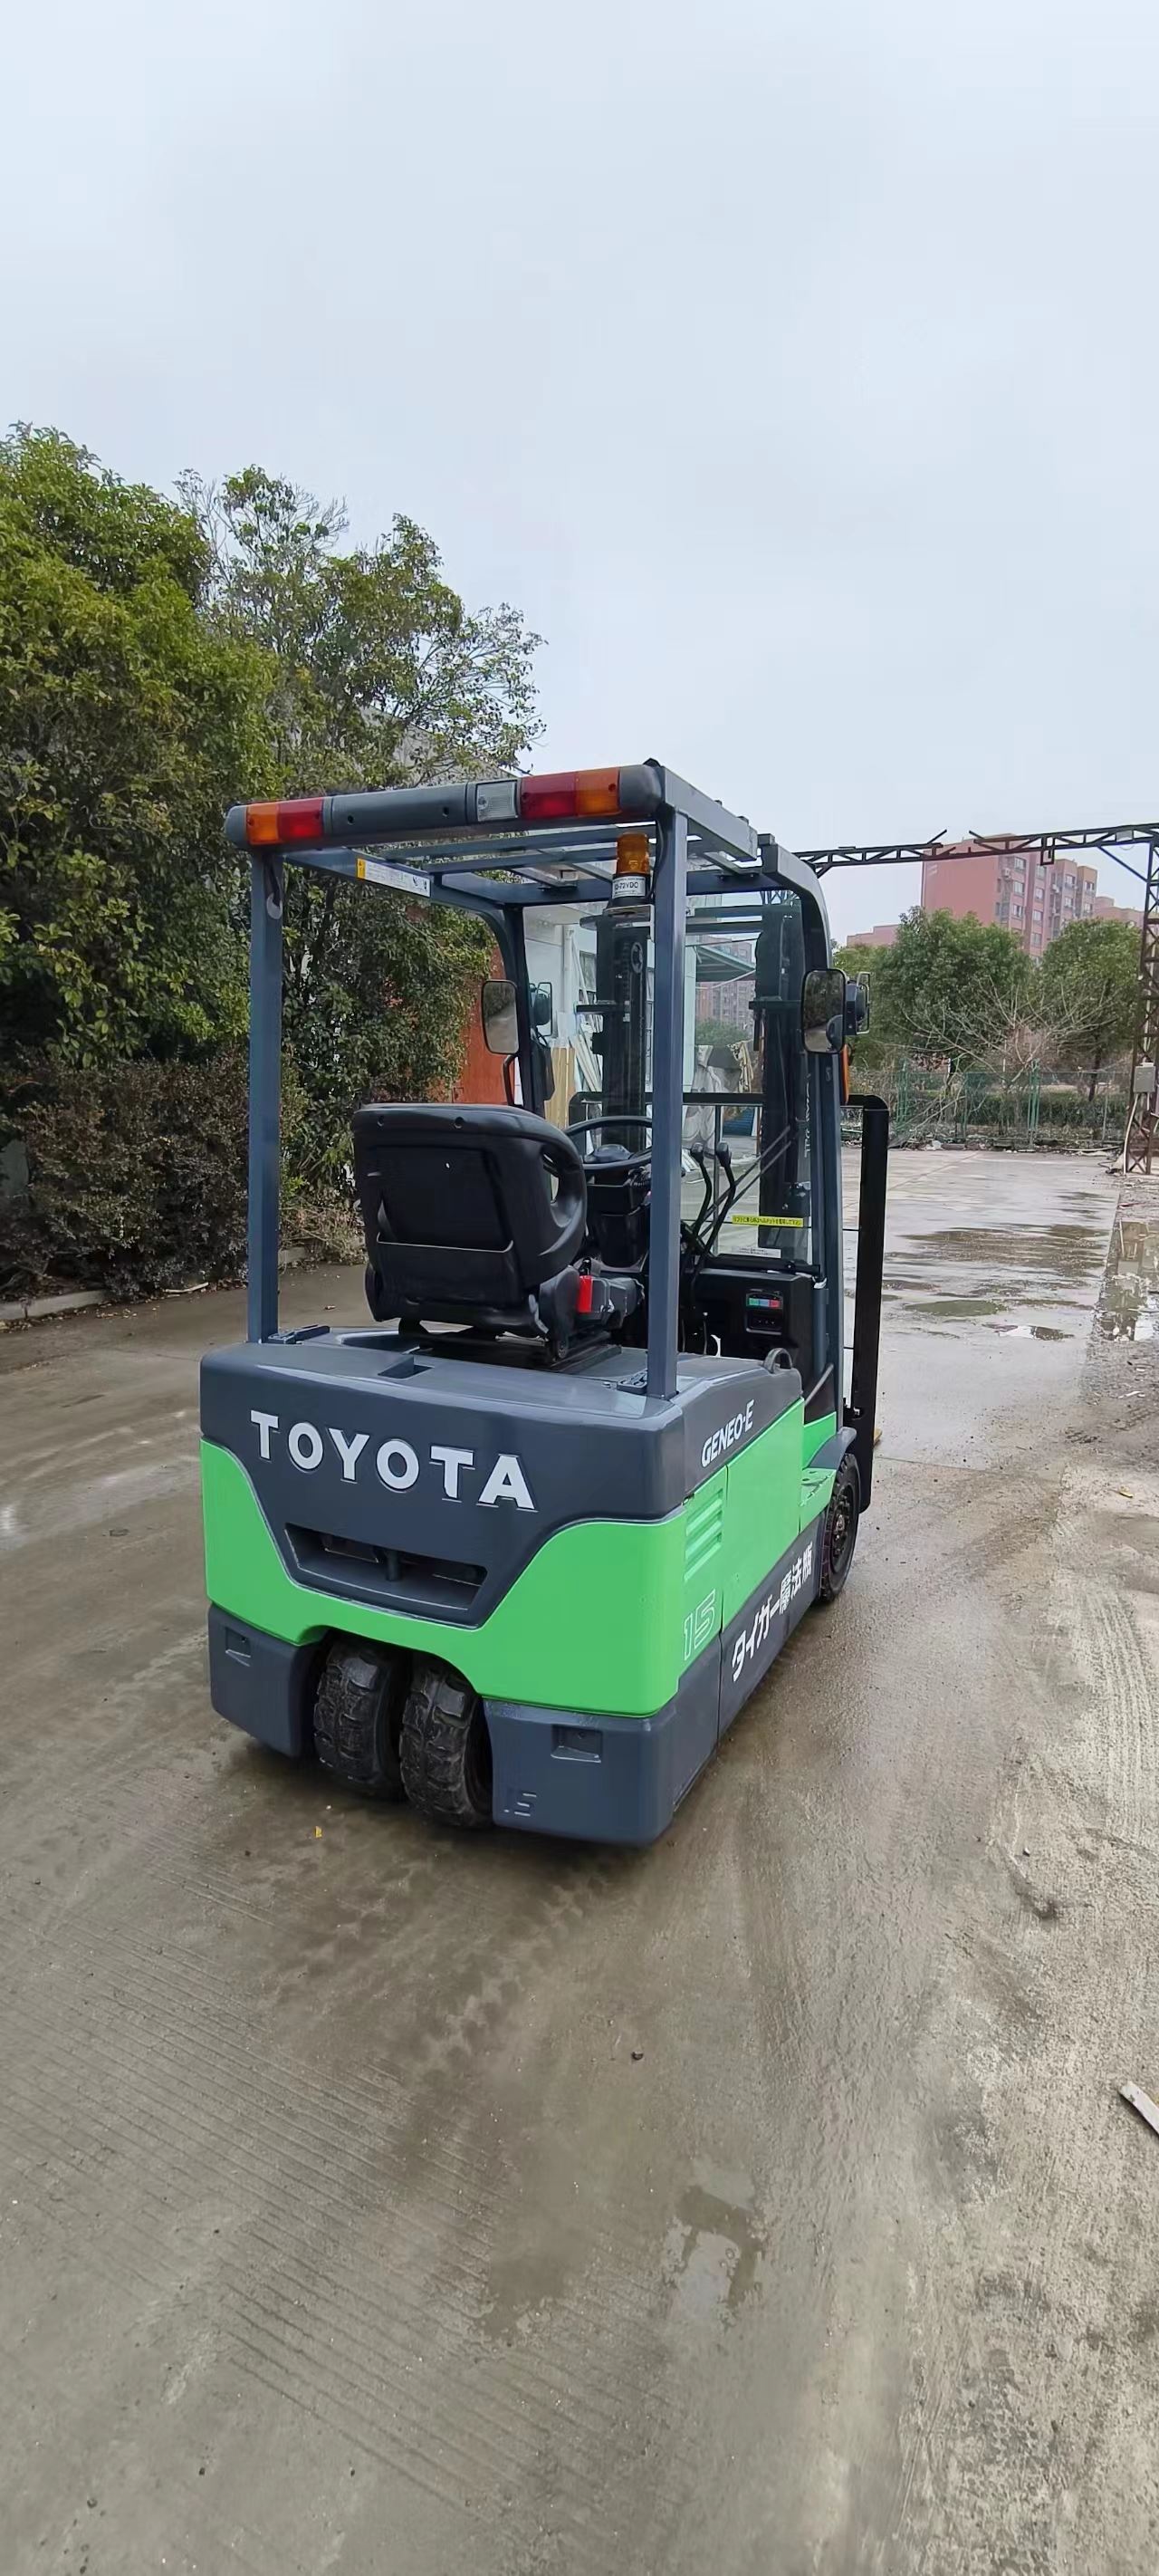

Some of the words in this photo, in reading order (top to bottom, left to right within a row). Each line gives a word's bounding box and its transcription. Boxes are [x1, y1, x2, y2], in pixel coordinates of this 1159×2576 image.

[250, 1409, 535, 1510] TOYOTA
[701, 1399, 754, 1467] GENEO-E
[684, 1588, 715, 1661] 15
